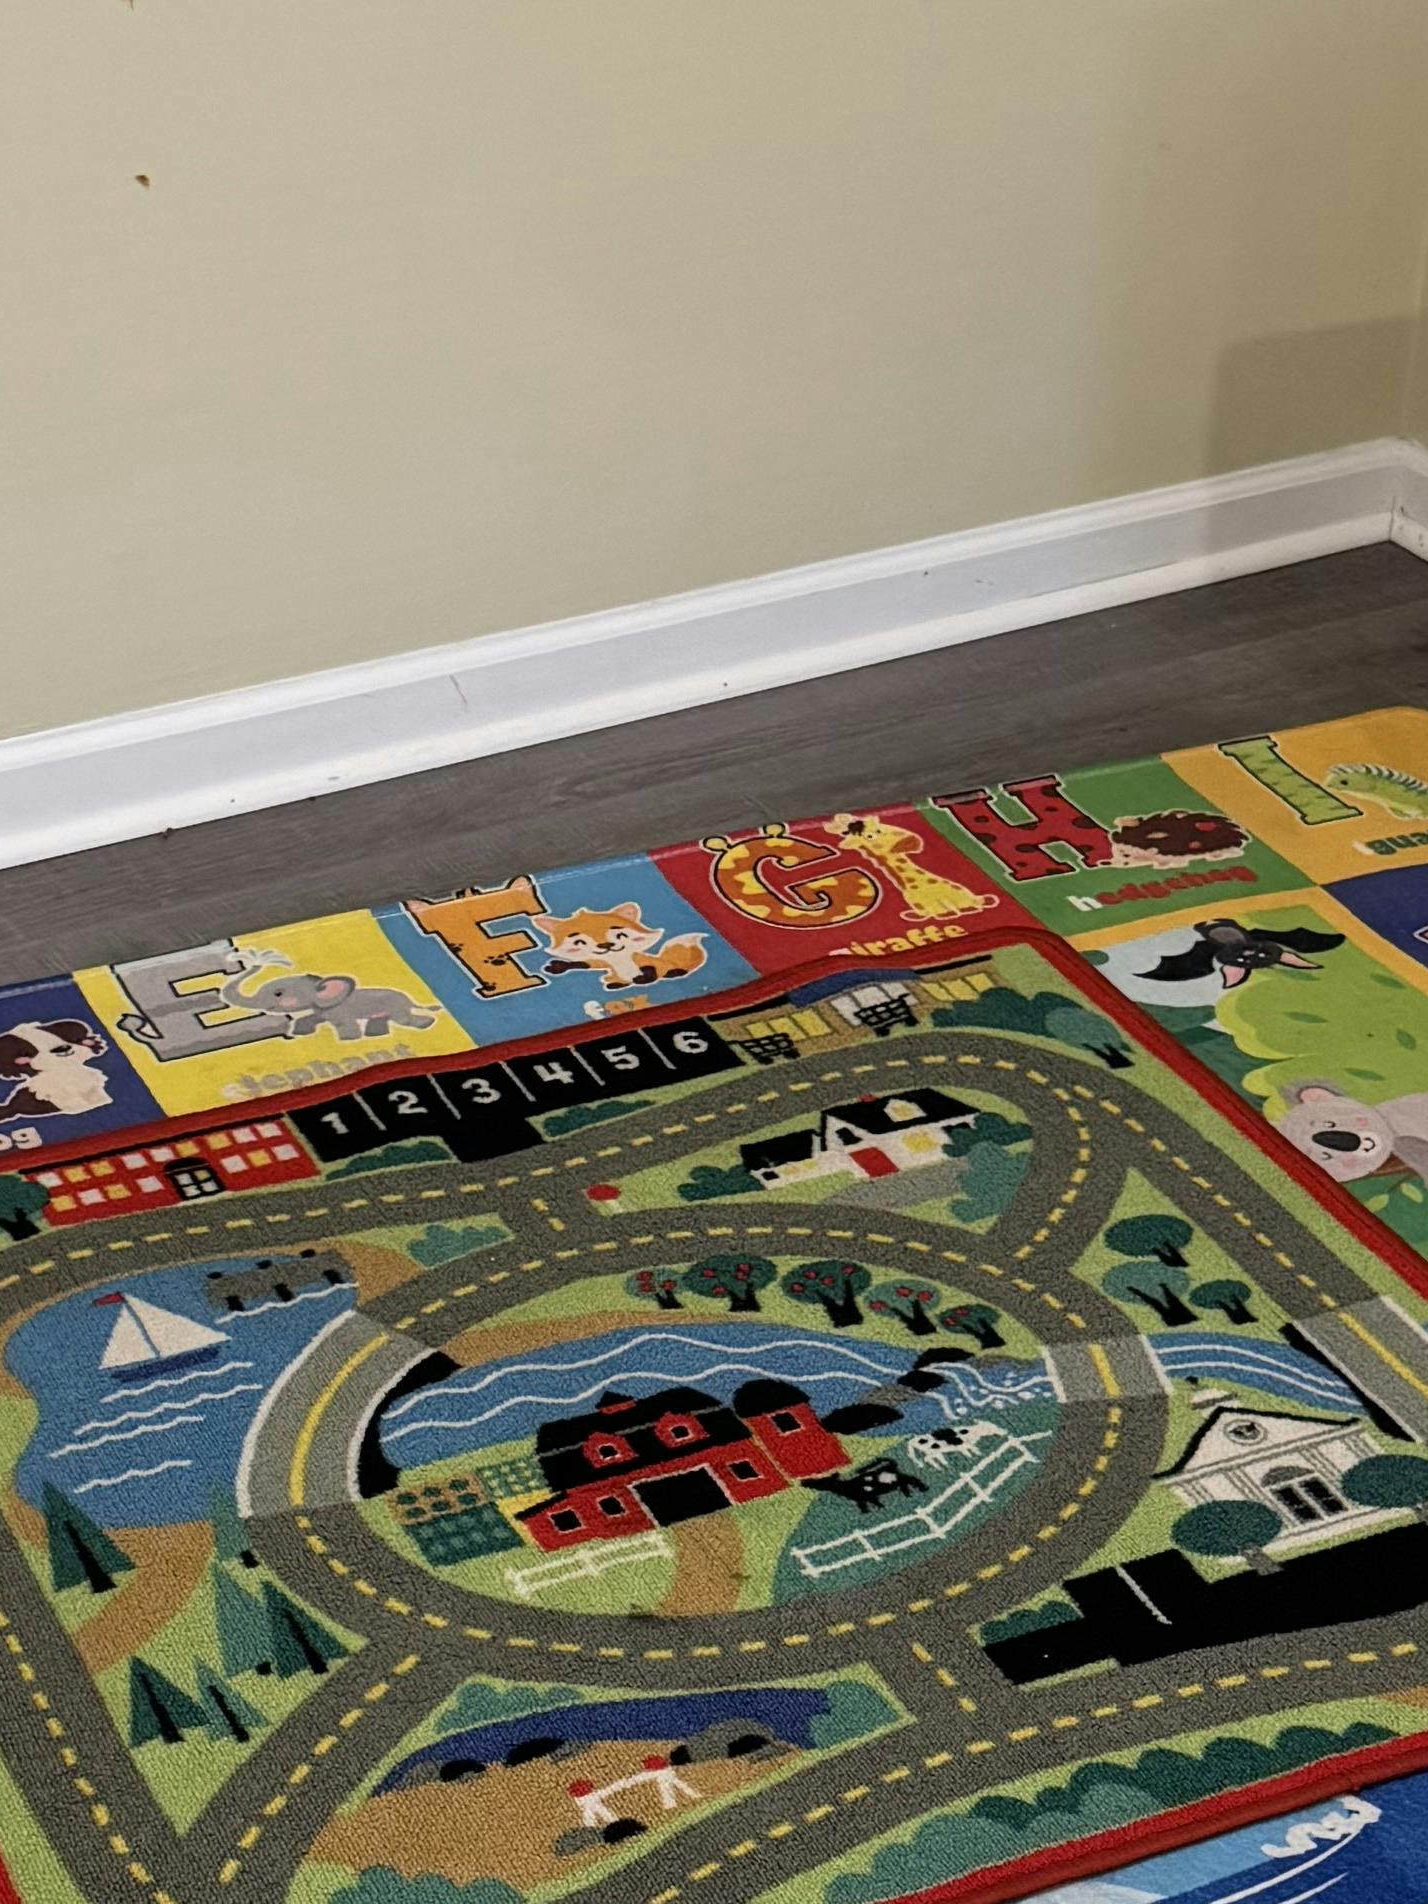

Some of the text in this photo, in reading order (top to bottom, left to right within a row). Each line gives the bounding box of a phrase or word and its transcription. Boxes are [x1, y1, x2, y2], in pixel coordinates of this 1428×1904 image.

[929, 774, 1117, 880] H
[1215, 735, 1364, 826] I
[700, 823, 881, 930] G
[400, 874, 550, 997] F
[116, 938, 294, 1063] E
[321, 1030, 709, 1134] 1 2 3 4 5 6
